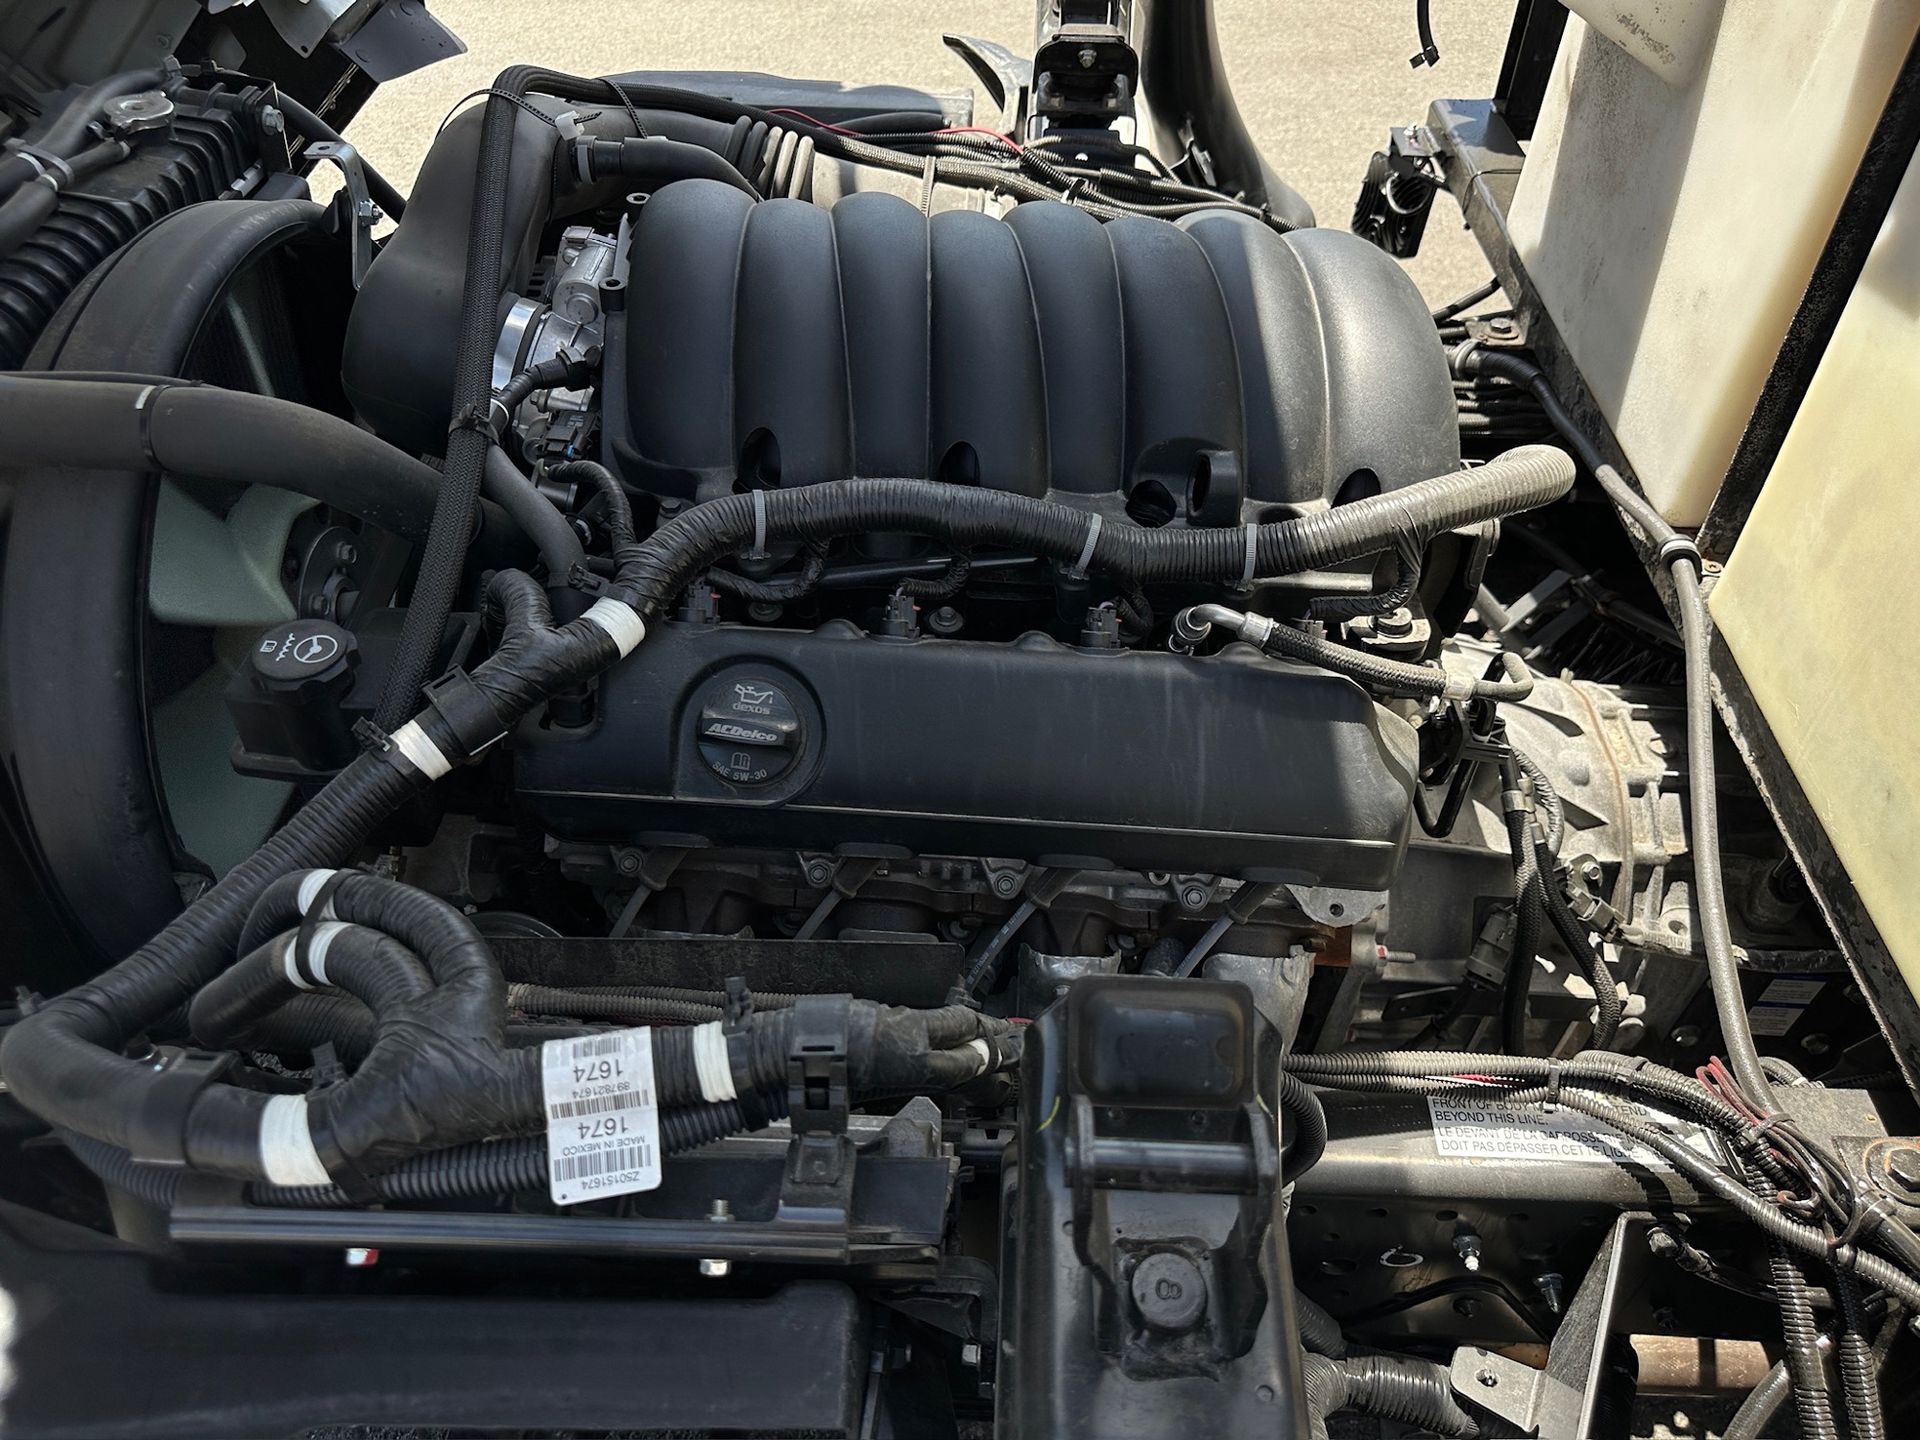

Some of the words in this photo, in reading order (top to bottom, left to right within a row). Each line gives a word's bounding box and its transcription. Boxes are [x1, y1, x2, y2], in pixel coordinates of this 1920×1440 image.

[732, 701, 771, 715] dexos
[708, 723, 778, 742] ACDelco
[712, 761, 732, 777] SAE
[732, 768, 768, 782] 5W-30
[573, 1059, 624, 1083] 1674
[1435, 1110, 1485, 1123] BEYOND
[1486, 1112, 1515, 1124] THIS
[1517, 1114, 1549, 1126] LINE.
[578, 1116, 629, 1140] 1674
[1438, 1126, 1454, 1138] LE
[562, 1142, 602, 1157] MEXICO
[603, 1138, 615, 1149] IN
[616, 1135, 645, 1148] MADE
[1441, 1139, 1469, 1151] DOIT
[1472, 1140, 1495, 1152] PAS
[1497, 1140, 1559, 1155] DÉPASSER
